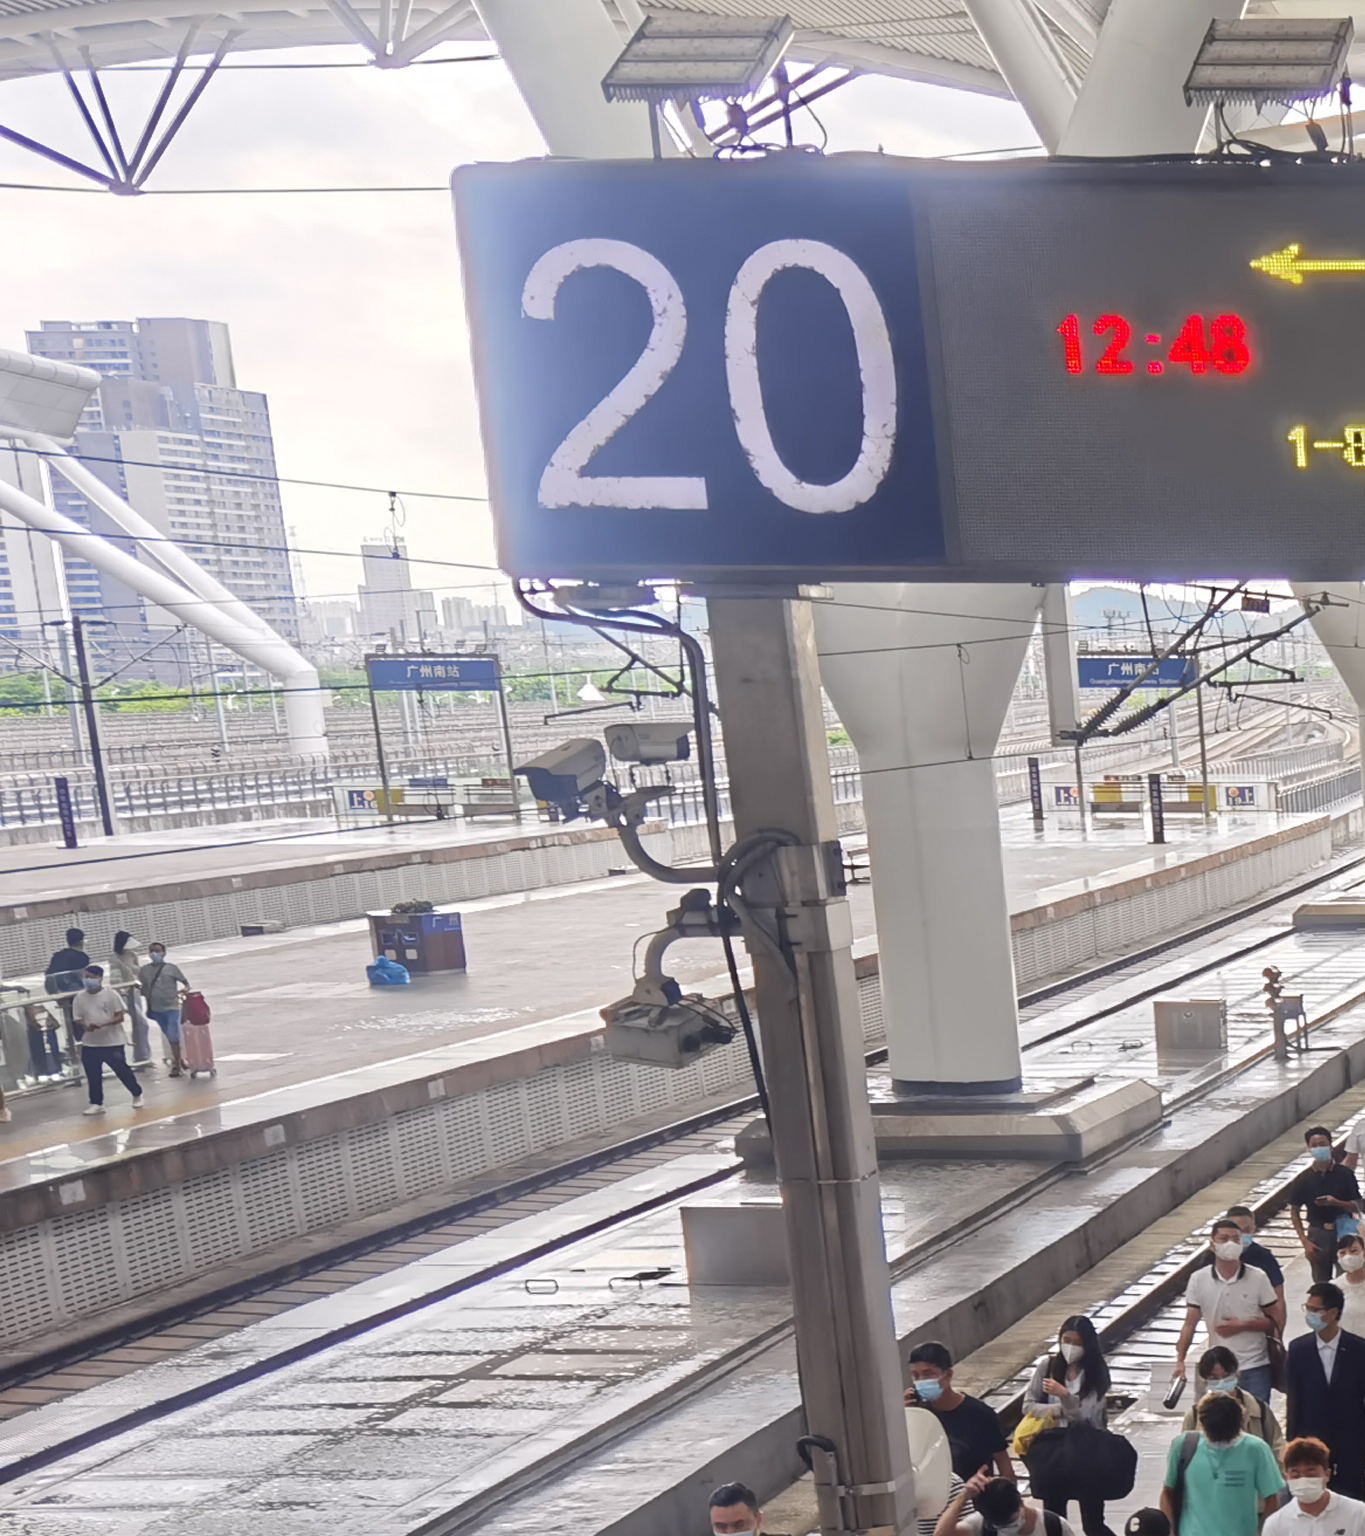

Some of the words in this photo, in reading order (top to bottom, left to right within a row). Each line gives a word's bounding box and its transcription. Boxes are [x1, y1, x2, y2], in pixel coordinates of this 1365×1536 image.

[1056, 312, 1253, 376] 12:48
[520, 238, 897, 515] 20
[407, 664, 460, 678] 广州南站
[352, 793, 364, 808] 上
